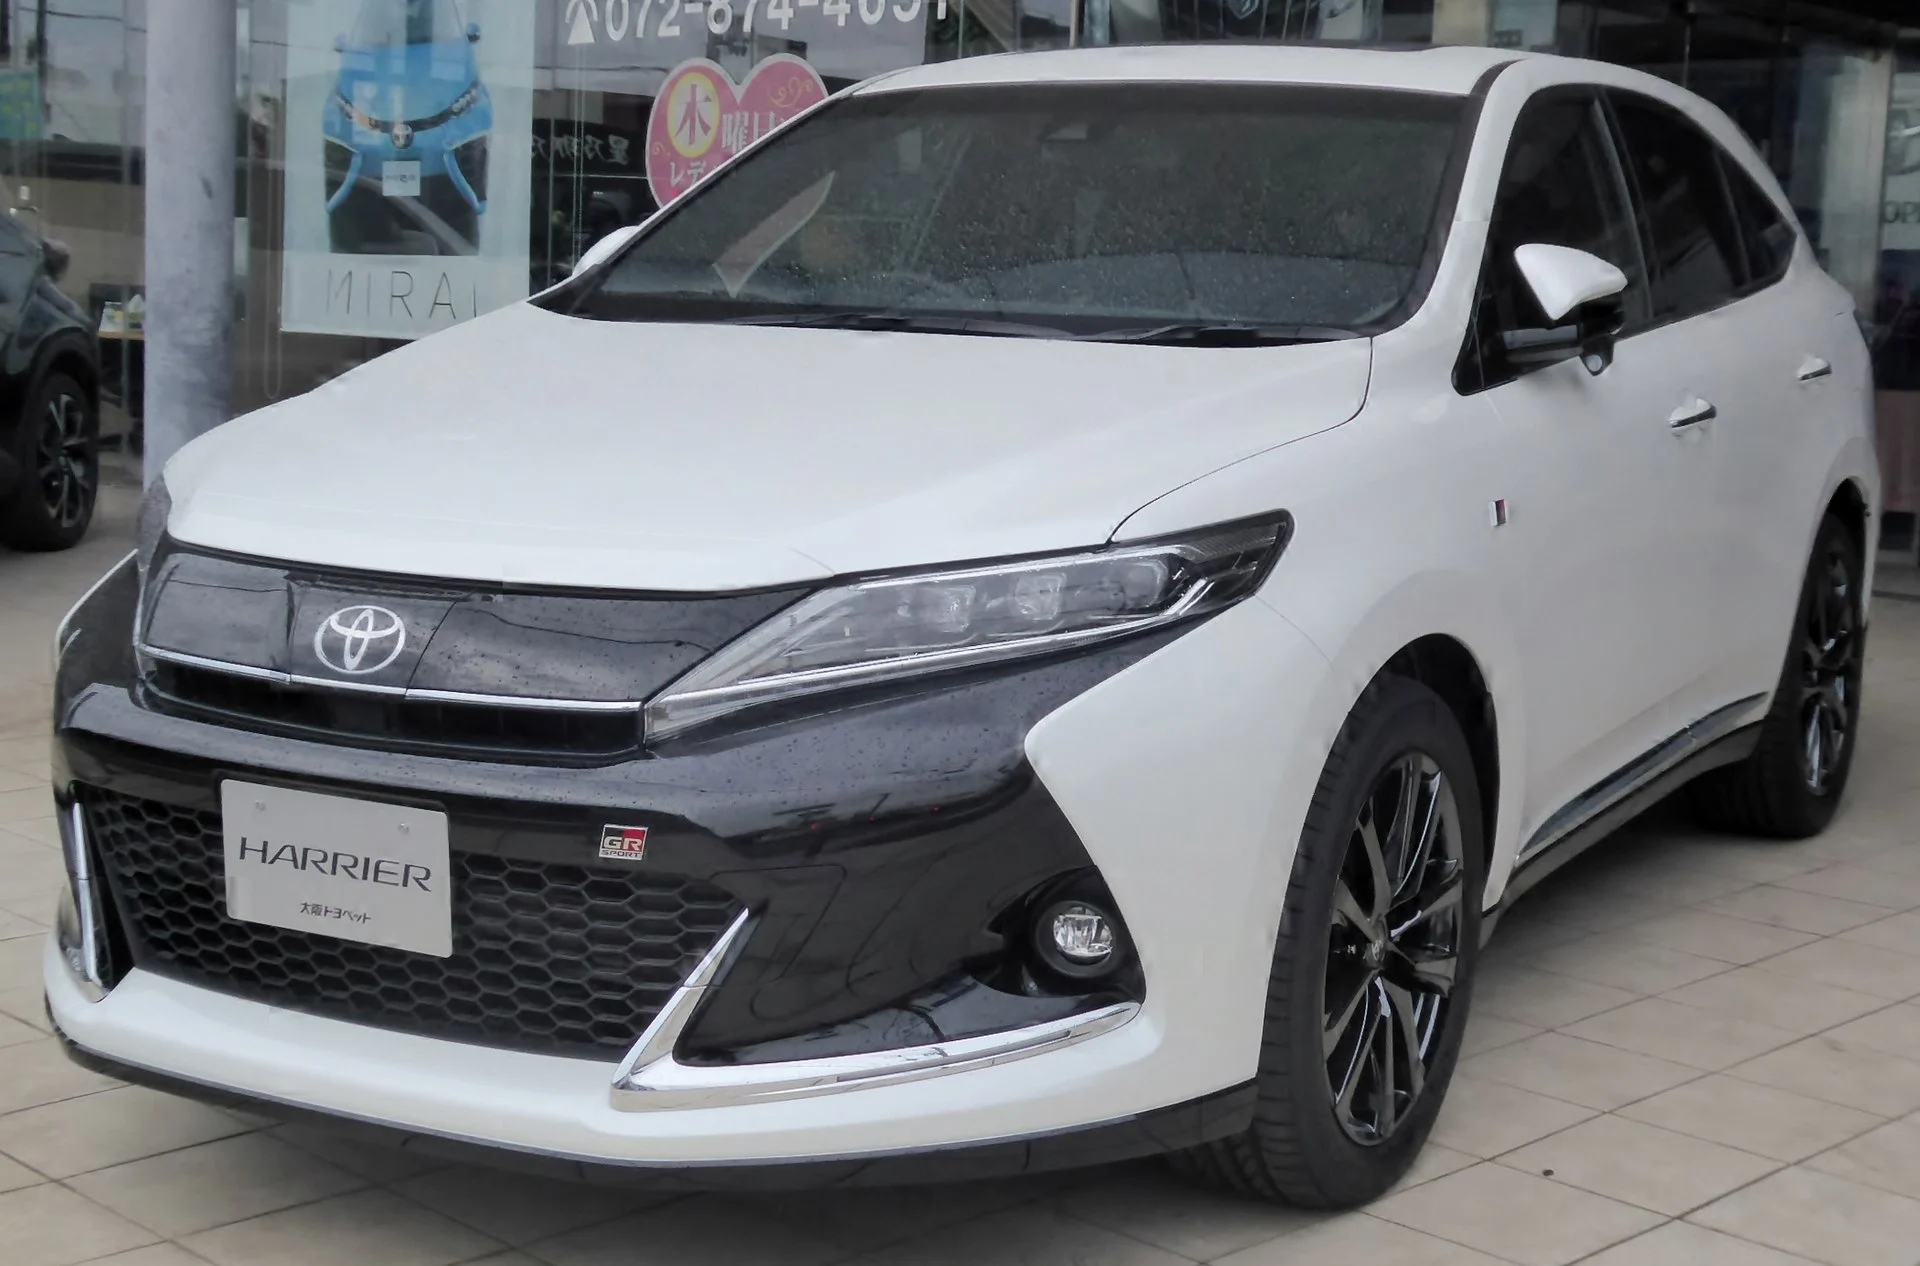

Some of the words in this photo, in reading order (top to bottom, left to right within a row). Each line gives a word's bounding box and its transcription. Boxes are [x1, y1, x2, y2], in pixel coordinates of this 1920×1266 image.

[326, 269, 478, 319] MIRAI
[601, 849, 641, 858] SPORT
[603, 836, 643, 851] GR
[239, 836, 432, 892] HARRIER
[300, 902, 372, 924] 大阪トヨペット
